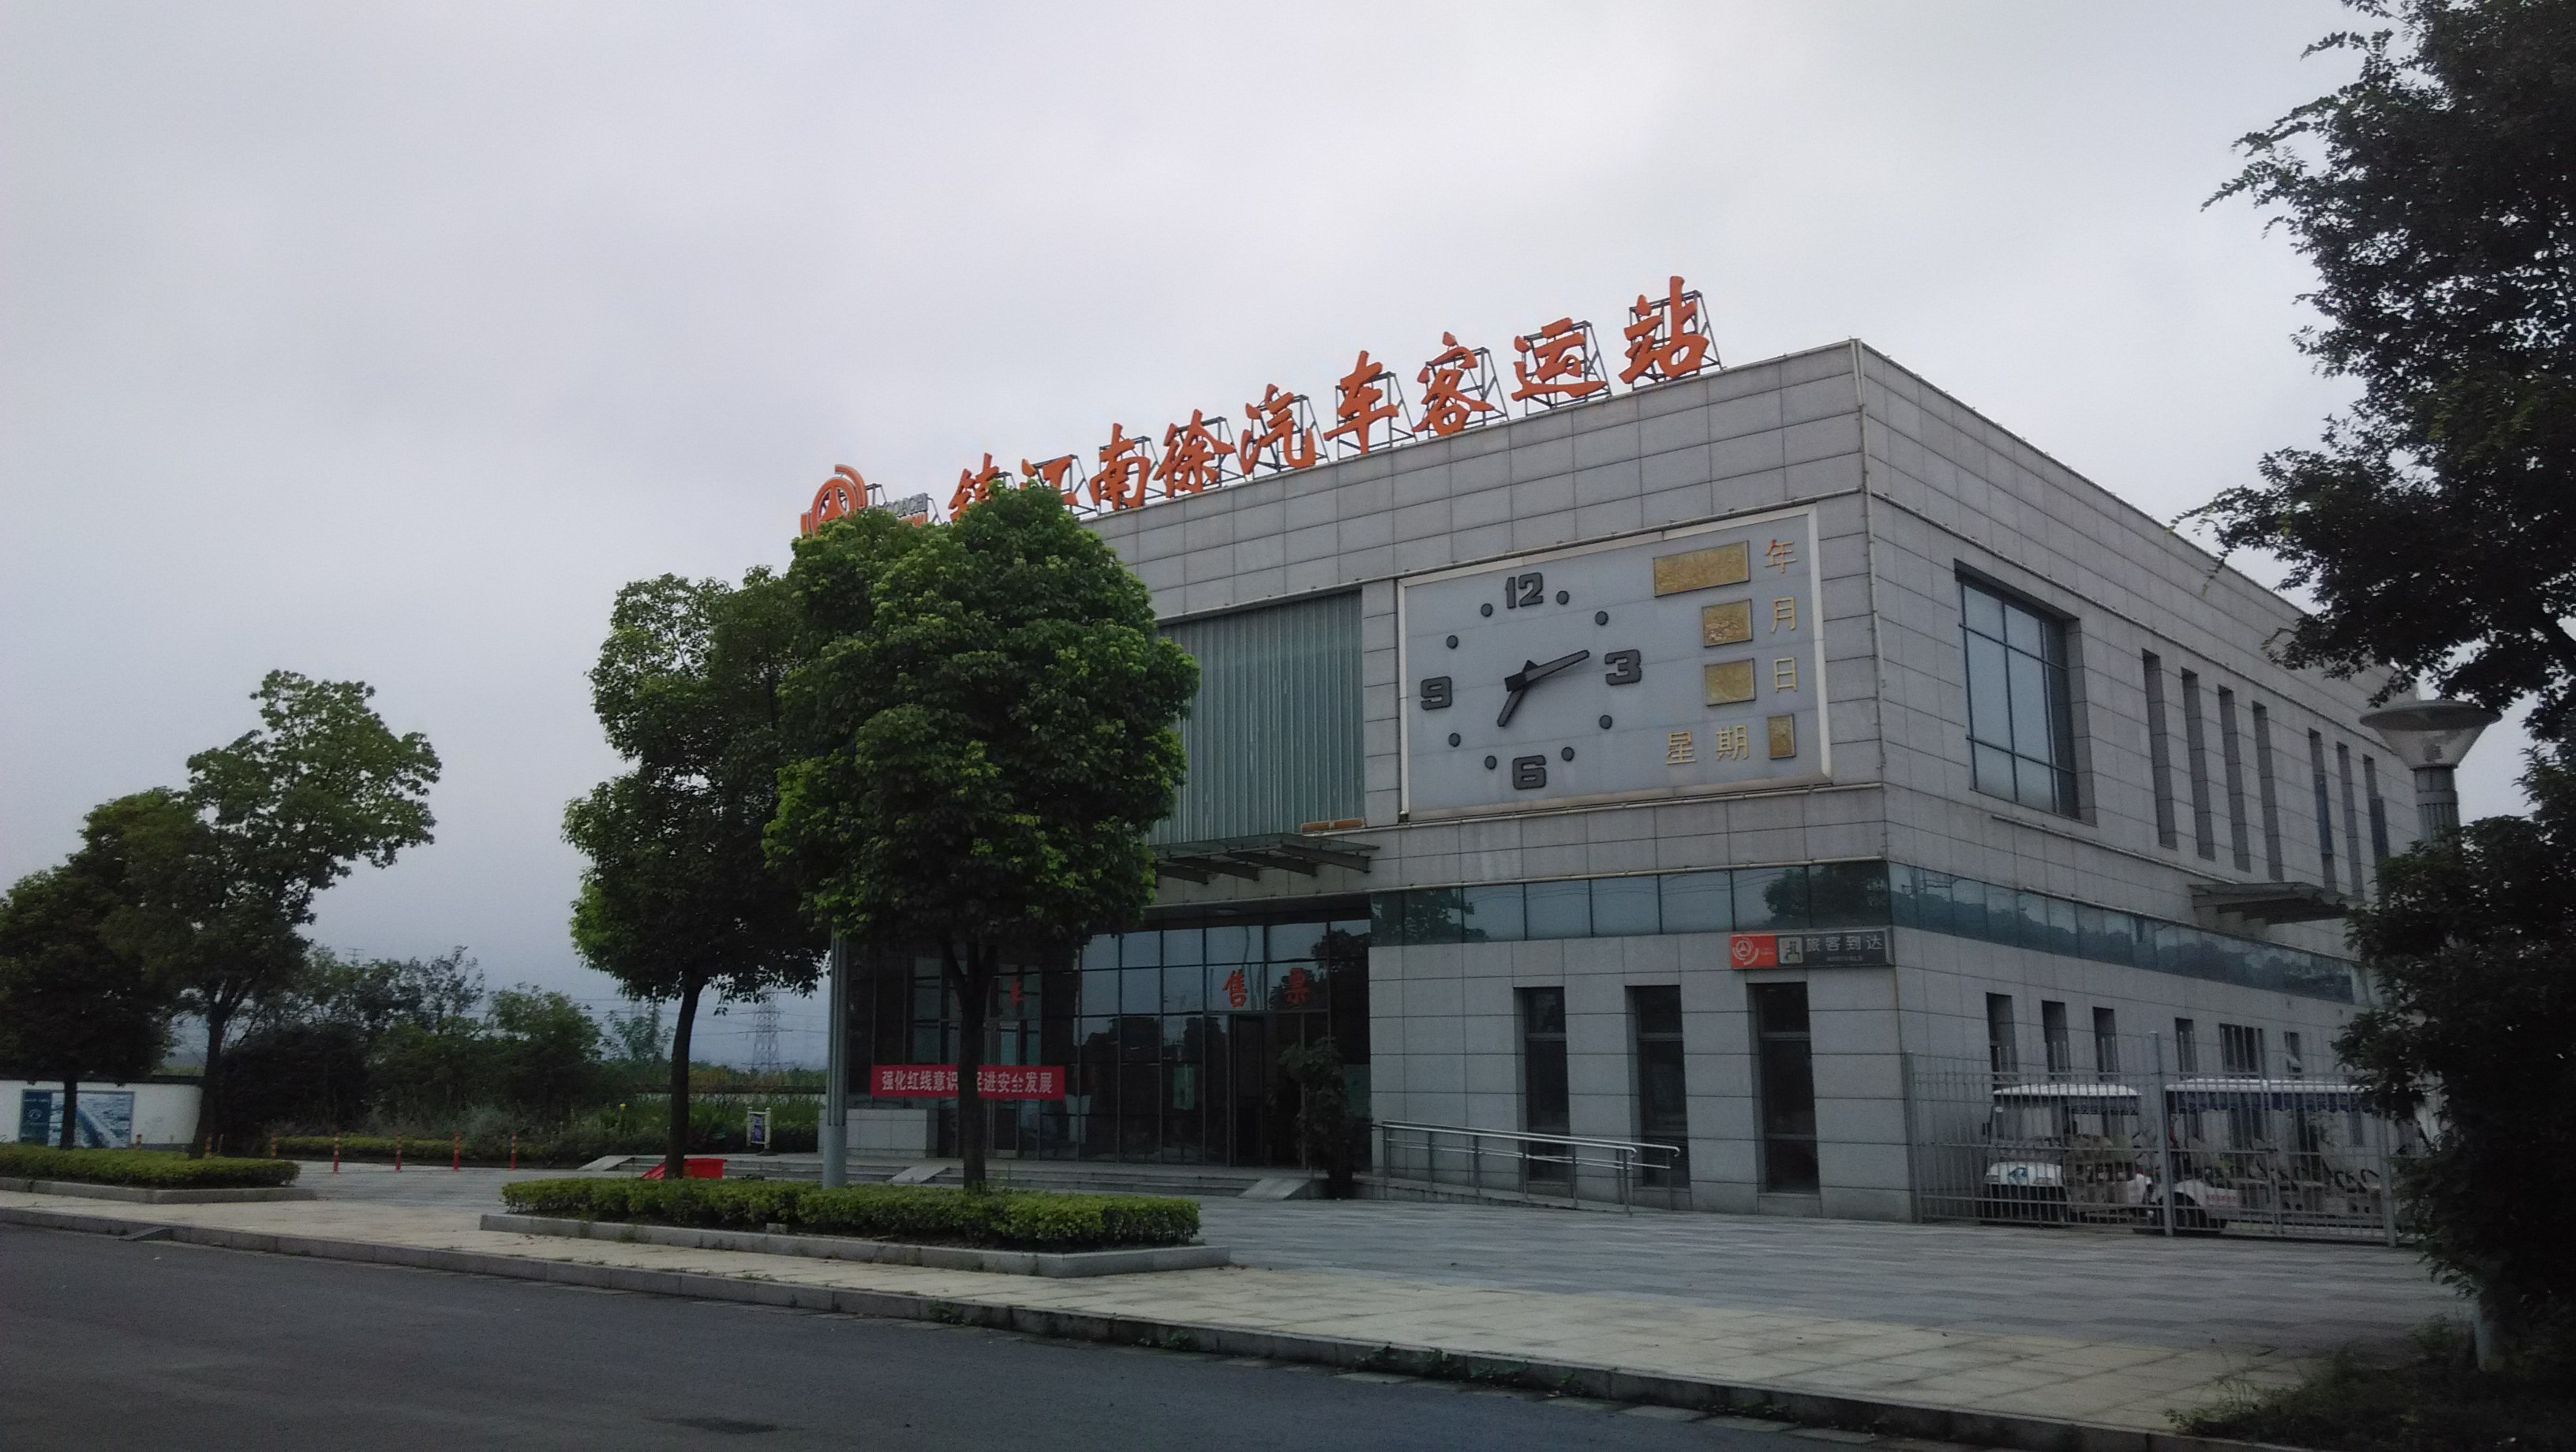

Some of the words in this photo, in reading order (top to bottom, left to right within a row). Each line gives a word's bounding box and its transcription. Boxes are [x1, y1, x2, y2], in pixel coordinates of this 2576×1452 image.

[948, 275, 1709, 522] 镇江南徐汽车客运站
[1765, 539, 1797, 573] 年
[1505, 571, 1544, 609] 12
[1770, 596, 1796, 633] 月
[1604, 649, 1642, 686] 3
[1774, 657, 1797, 692] 日
[1421, 675, 1452, 710] 9
[1667, 724, 1750, 765] 星期
[1512, 754, 1547, 790] 6
[1806, 934, 1883, 952] 旅客到达
[1222, 967, 1312, 1008] 售票
[882, 1070, 959, 1093] 强化红线意识
